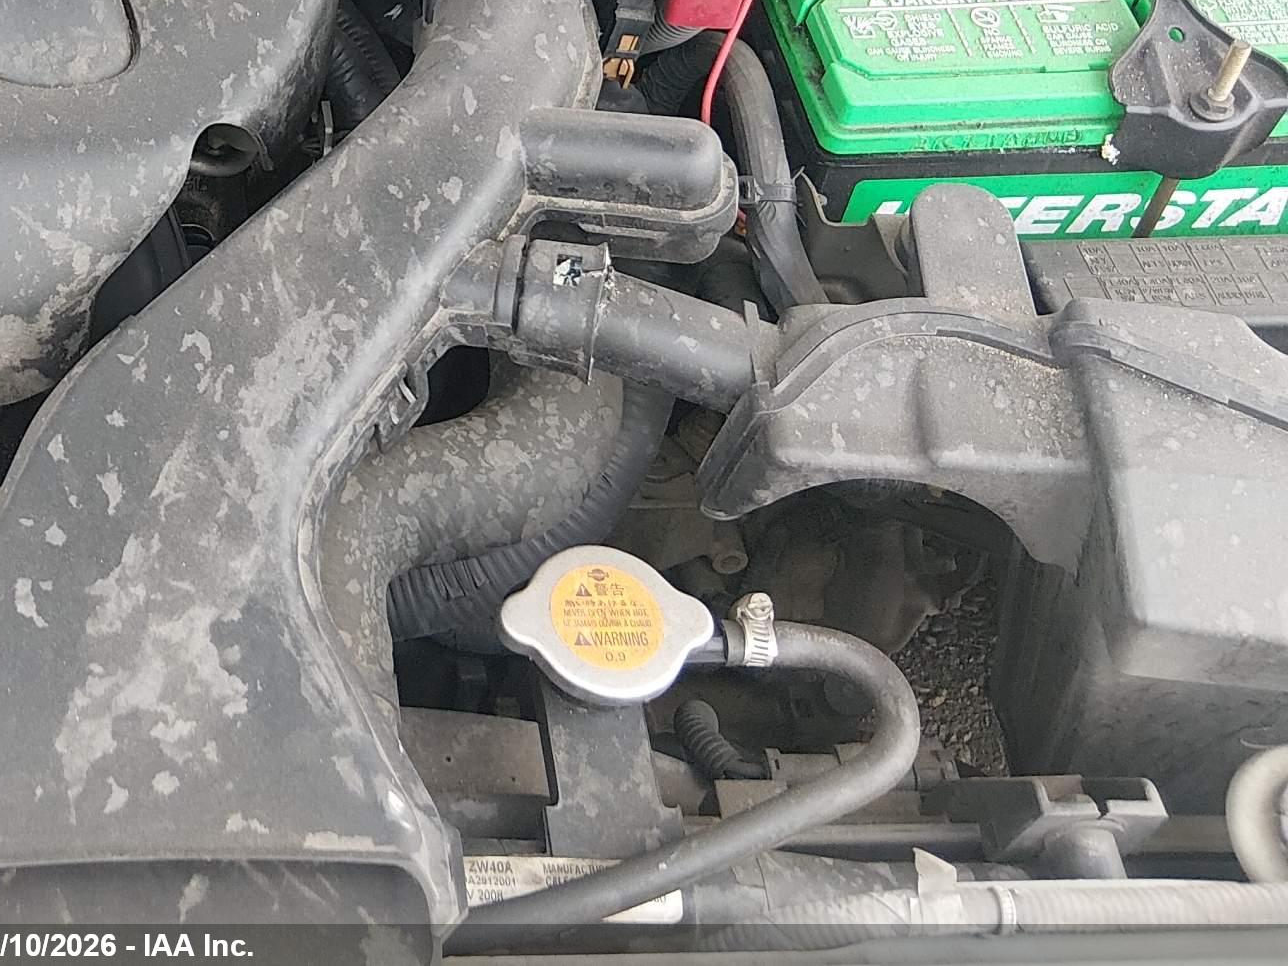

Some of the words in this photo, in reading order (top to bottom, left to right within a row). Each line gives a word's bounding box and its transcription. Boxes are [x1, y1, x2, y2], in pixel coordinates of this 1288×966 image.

[887, 28, 944, 38] EXPLOSIVE
[983, 28, 1001, 36] NO
[1041, 23, 1092, 34] SULFURIC
[1095, 22, 1119, 32] ACID
[563, 608, 586, 616] NEVER
[587, 608, 607, 617] OPEN
[608, 608, 631, 616] WHEN
[591, 631, 649, 646] WARNING
[604, 651, 626, 662] 0.9
